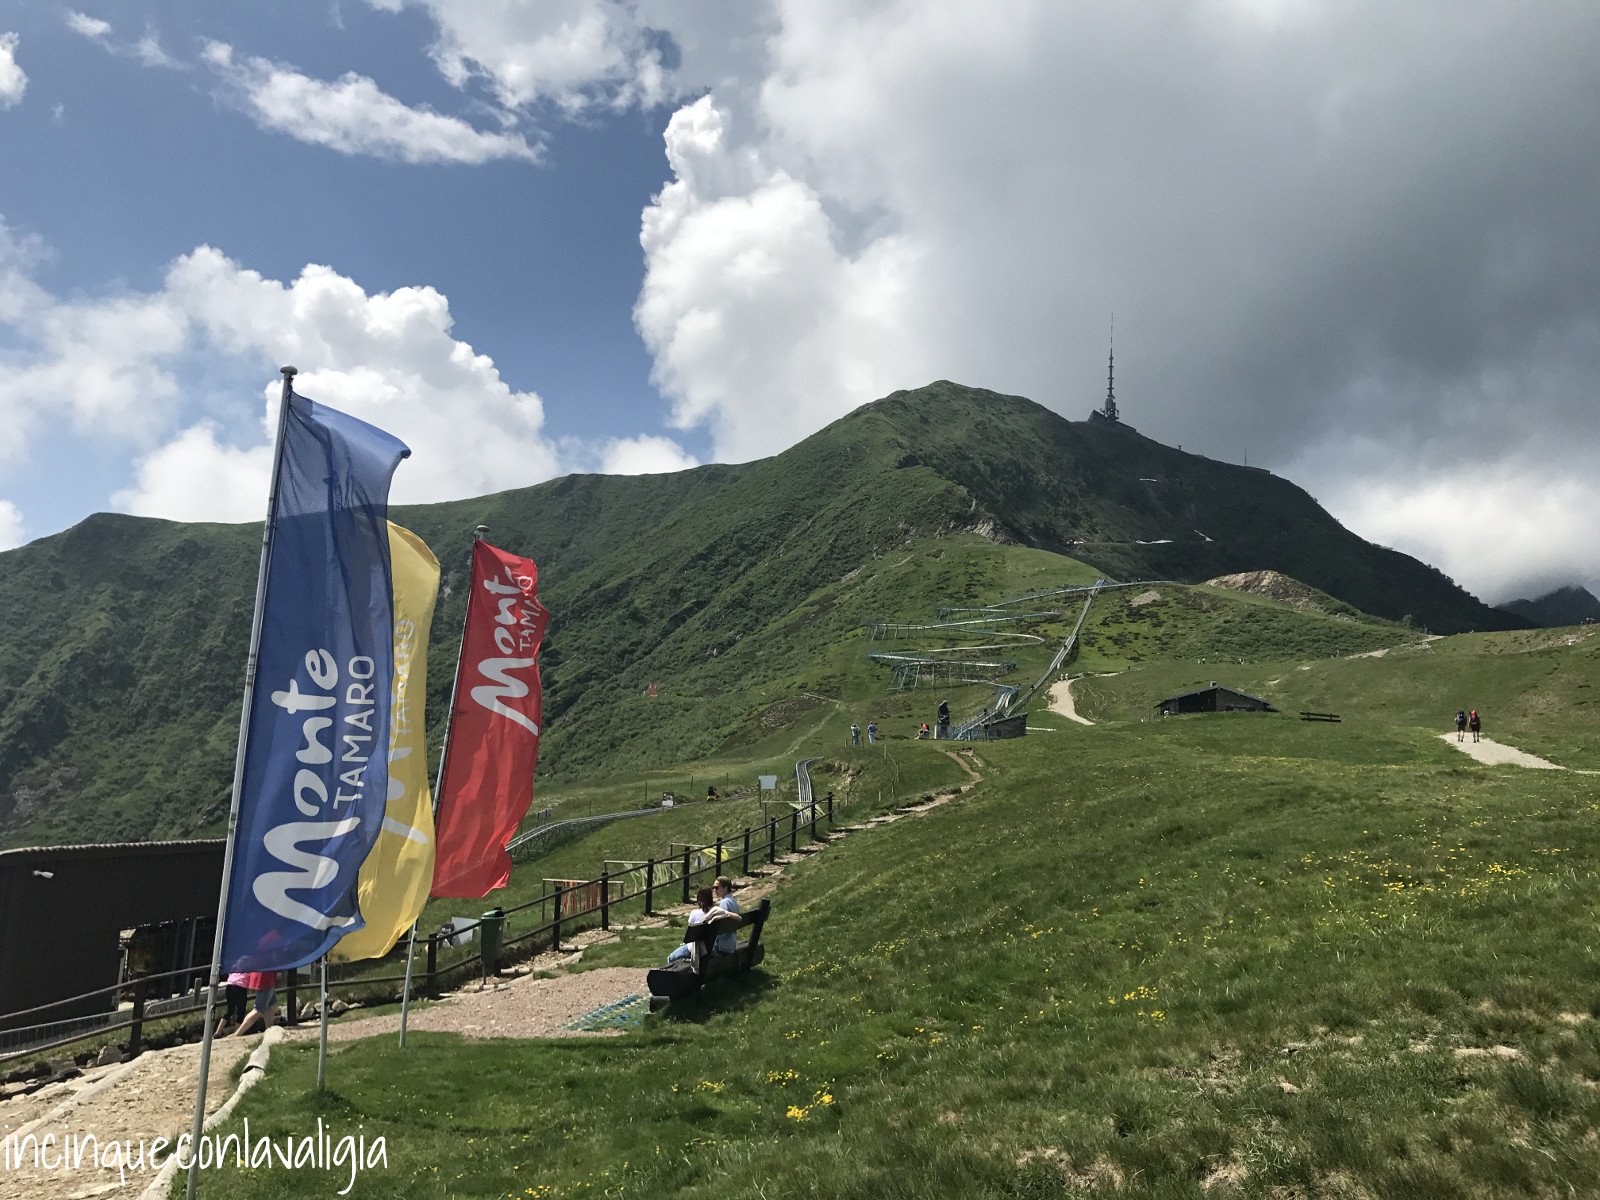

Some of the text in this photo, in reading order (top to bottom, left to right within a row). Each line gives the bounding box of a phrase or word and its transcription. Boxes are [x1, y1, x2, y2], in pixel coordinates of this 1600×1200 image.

[518, 575, 542, 652] TAMO
[252, 648, 361, 931] Monte
[333, 655, 375, 809] TAMARO
